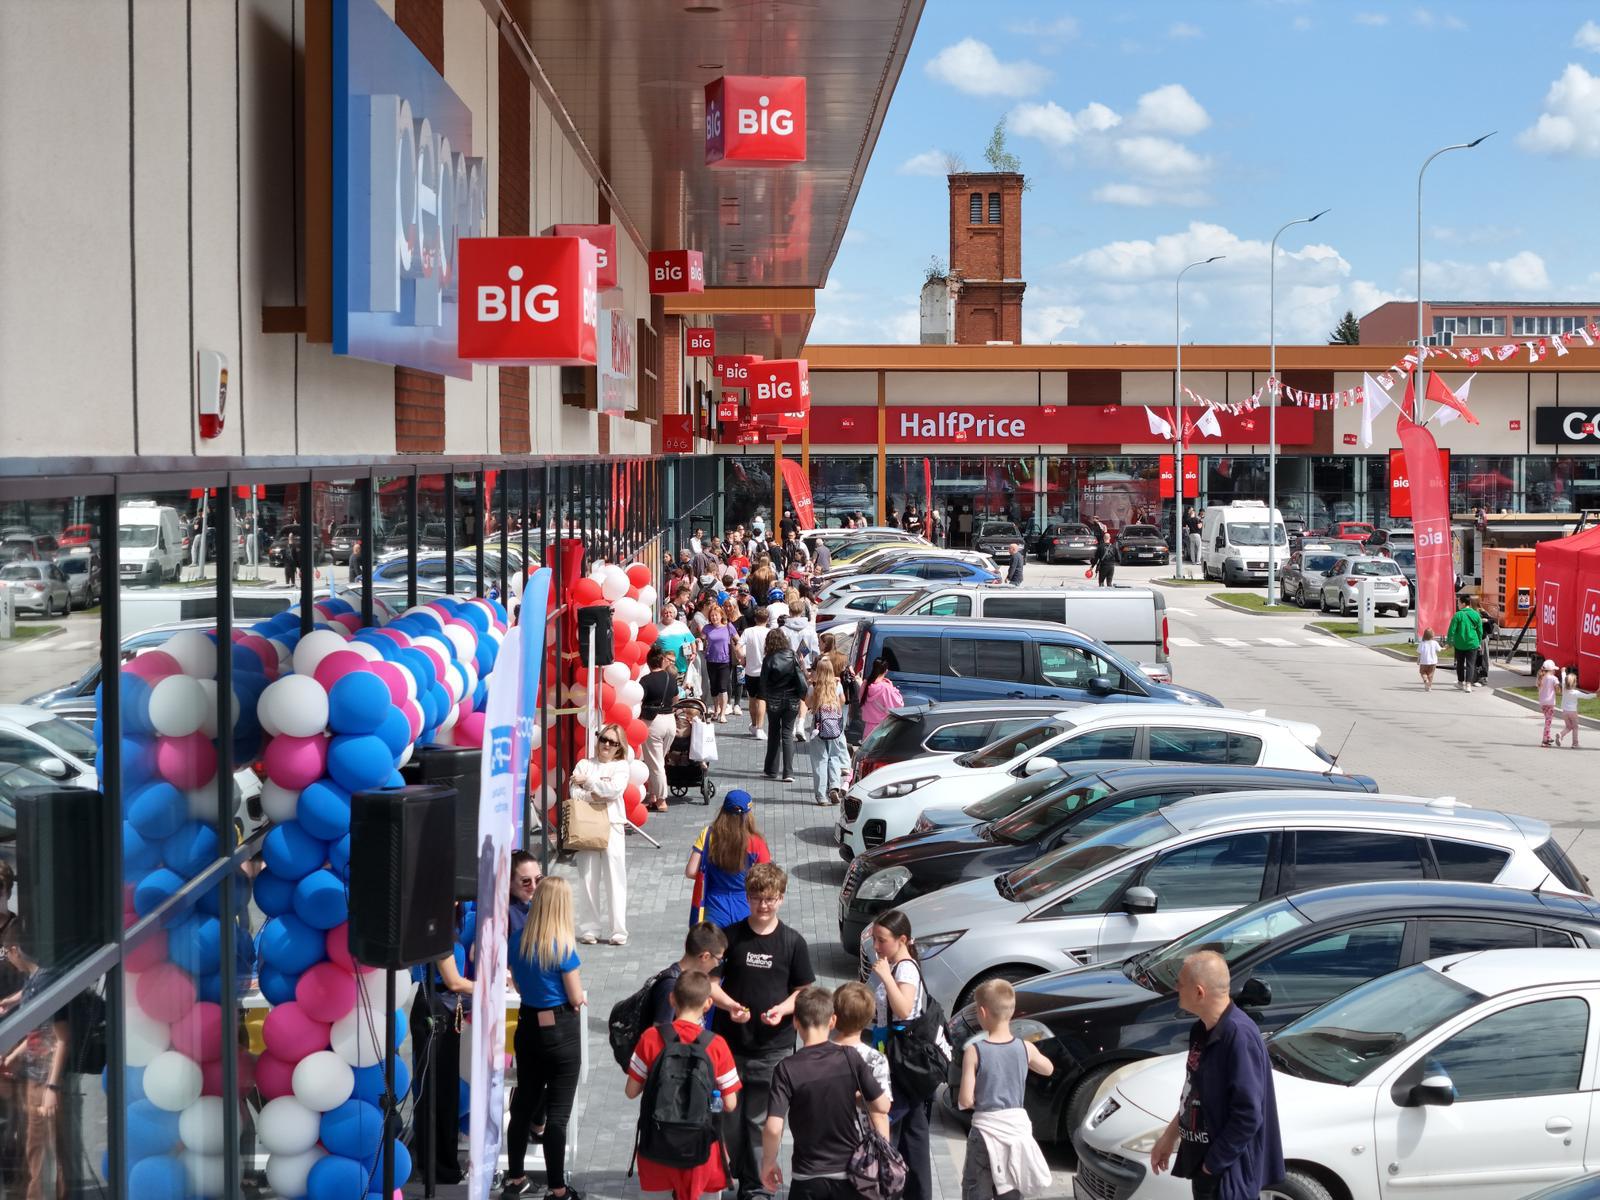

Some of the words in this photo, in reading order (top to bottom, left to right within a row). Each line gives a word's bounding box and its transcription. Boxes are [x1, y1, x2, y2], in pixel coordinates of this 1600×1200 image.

[738, 95, 794, 136] BiG
[655, 260, 683, 281] BiG
[477, 265, 560, 323] BiG
[691, 334, 711, 349] BiG
[726, 363, 748, 379] BiG
[757, 374, 793, 399] BiG
[900, 411, 1026, 437] HalfPrice
[1393, 476, 1409, 488] BiG
